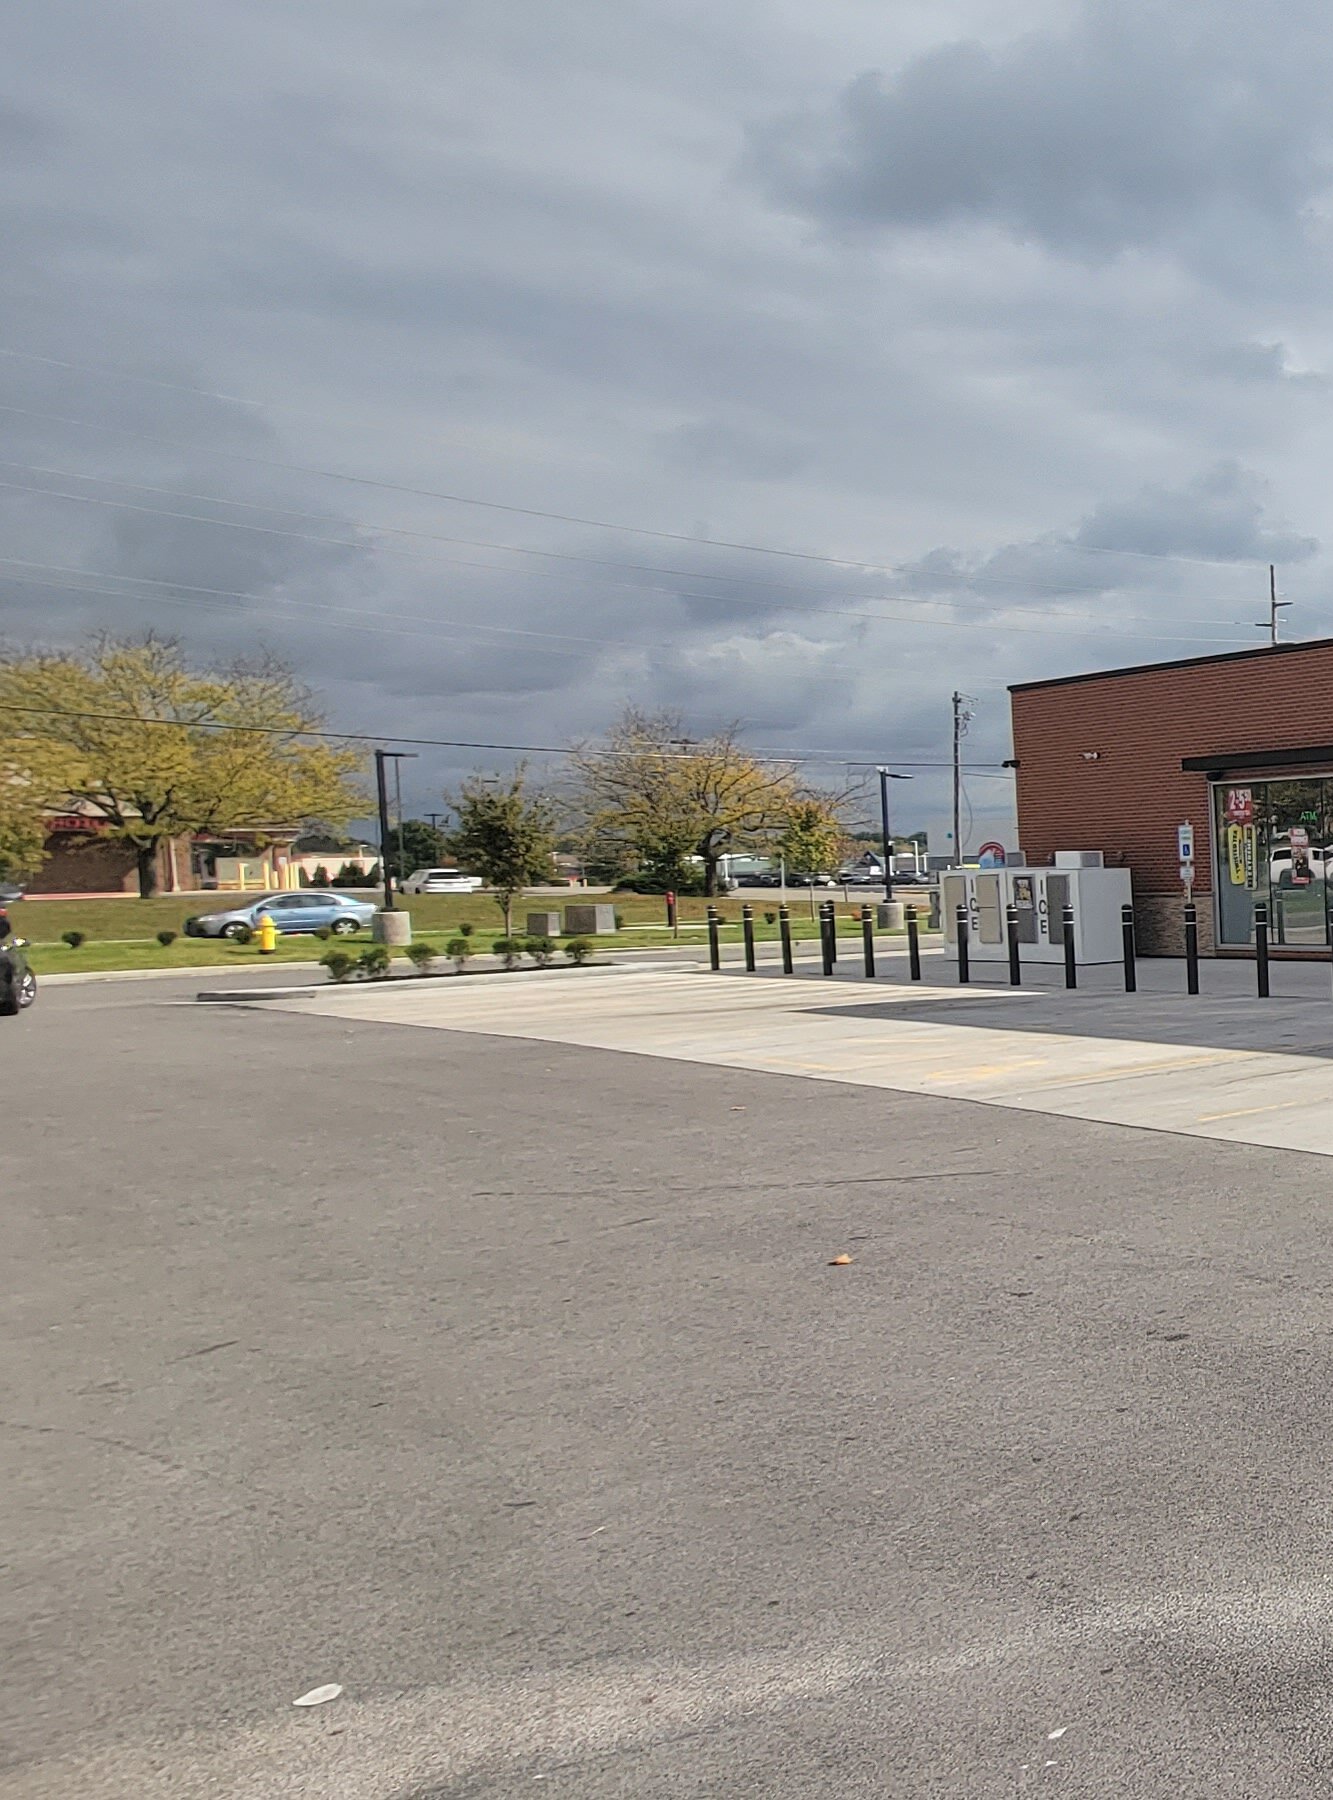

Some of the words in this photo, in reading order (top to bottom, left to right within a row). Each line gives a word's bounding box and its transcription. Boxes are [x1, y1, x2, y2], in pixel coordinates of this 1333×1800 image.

[1300, 811, 1317, 820] ATM
[969, 878, 980, 931] ICE
[1038, 880, 1048, 934] ICE
